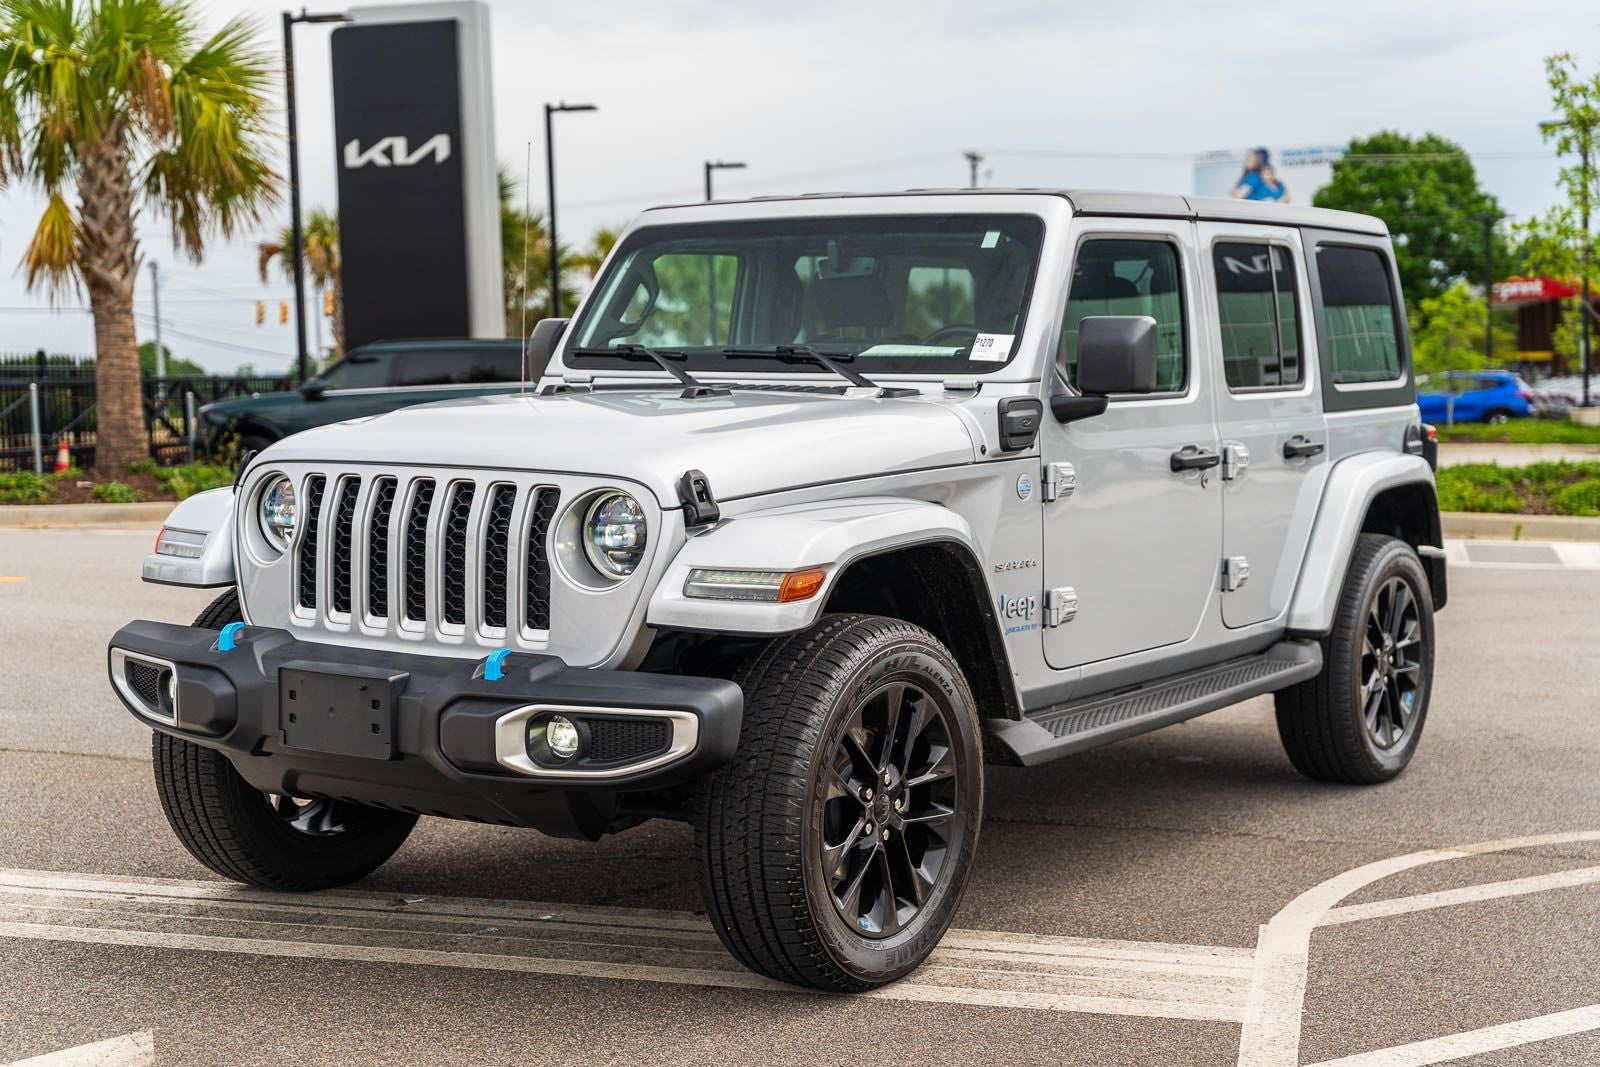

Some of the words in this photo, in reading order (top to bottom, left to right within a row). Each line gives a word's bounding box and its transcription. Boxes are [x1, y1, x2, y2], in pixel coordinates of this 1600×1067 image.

[344, 133, 451, 169] KIA
[974, 338, 994, 347] P1270
[994, 559, 1037, 573] SAHARA
[1000, 593, 1036, 621] Jeep
[922, 666, 953, 697] ALENZA
